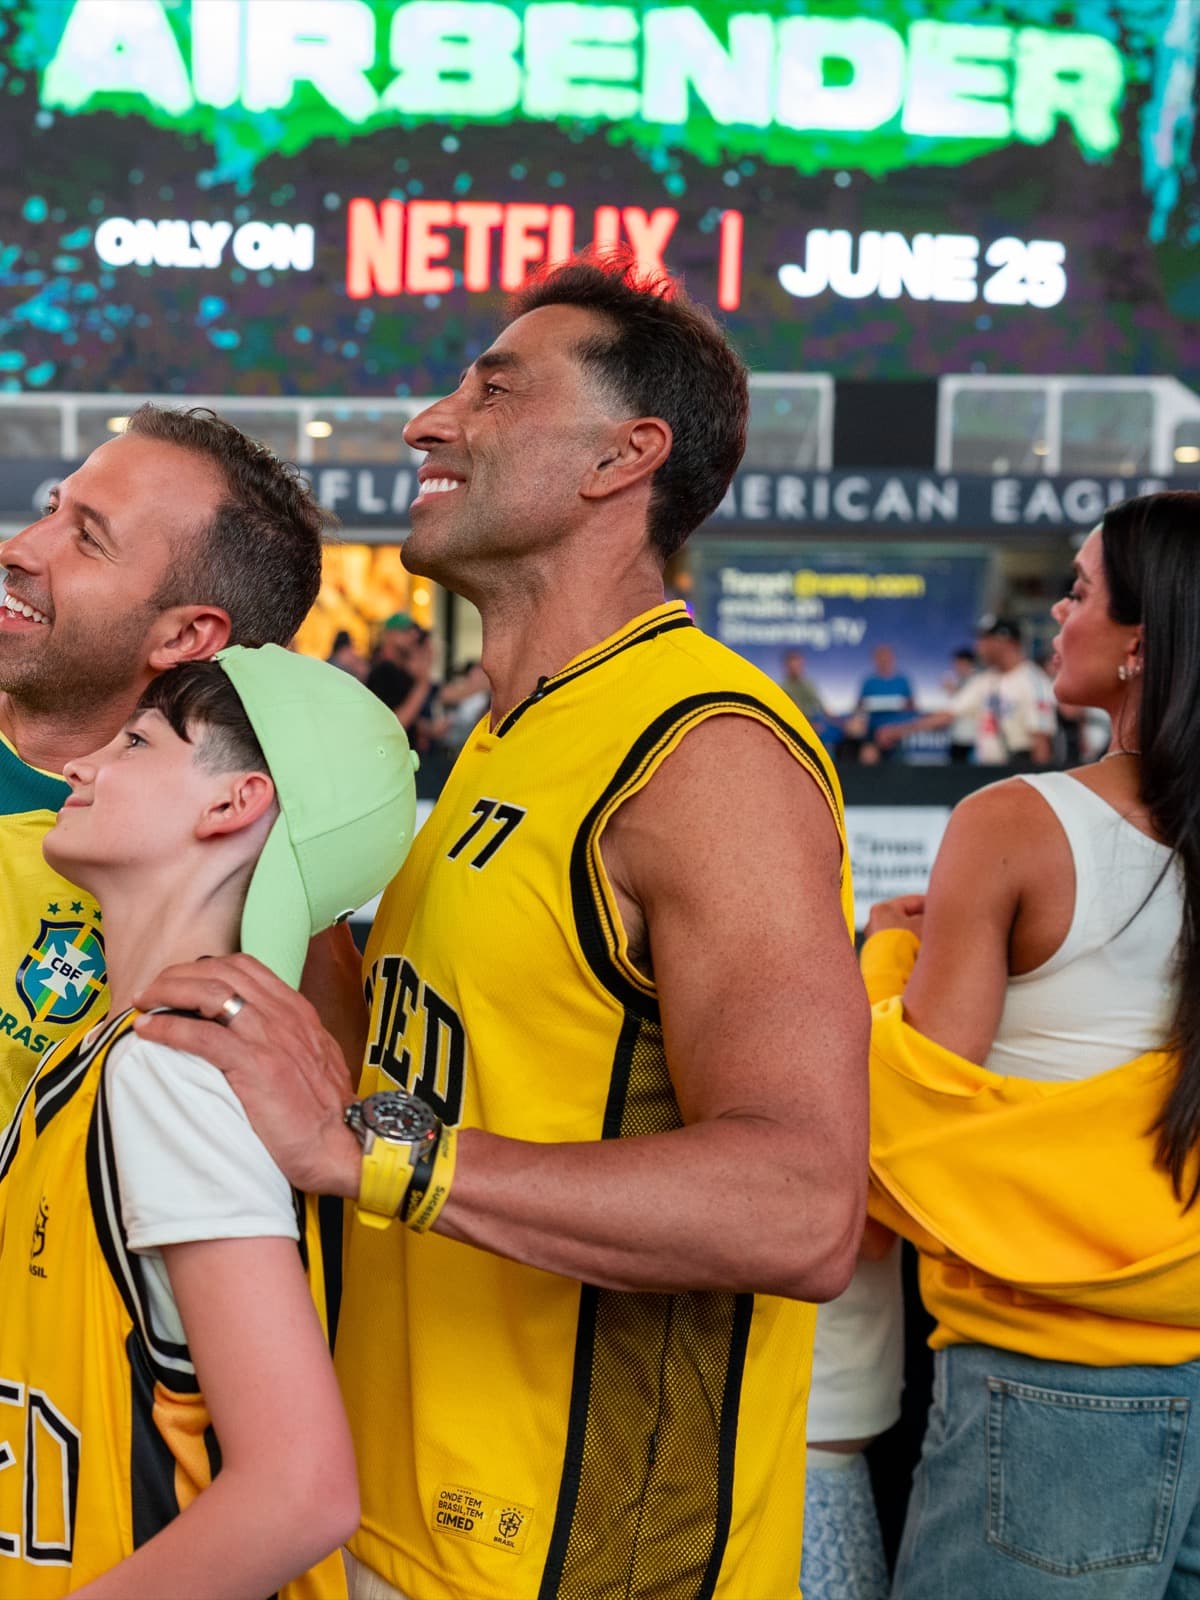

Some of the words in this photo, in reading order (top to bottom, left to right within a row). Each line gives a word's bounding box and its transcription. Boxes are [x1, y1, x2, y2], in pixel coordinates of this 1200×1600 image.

[40, 0, 1125, 153] AIRBENDER
[94, 216, 233, 268] ONLY
[232, 221, 315, 271] ON
[778, 228, 980, 303] JUNE
[983, 236, 1068, 308] 25
[712, 472, 960, 522] ERICAN
[991, 478, 1168, 524] EAG
[446, 797, 528, 872] 77
[50, 956, 83, 982] CBF
[440, 1491, 462, 1503] ONDE
[464, 1496, 481, 1508] TEM
[466, 1507, 483, 1519] TEM
[436, 1512, 474, 1531] CIMED
[493, 1536, 515, 1547] BRASIL
